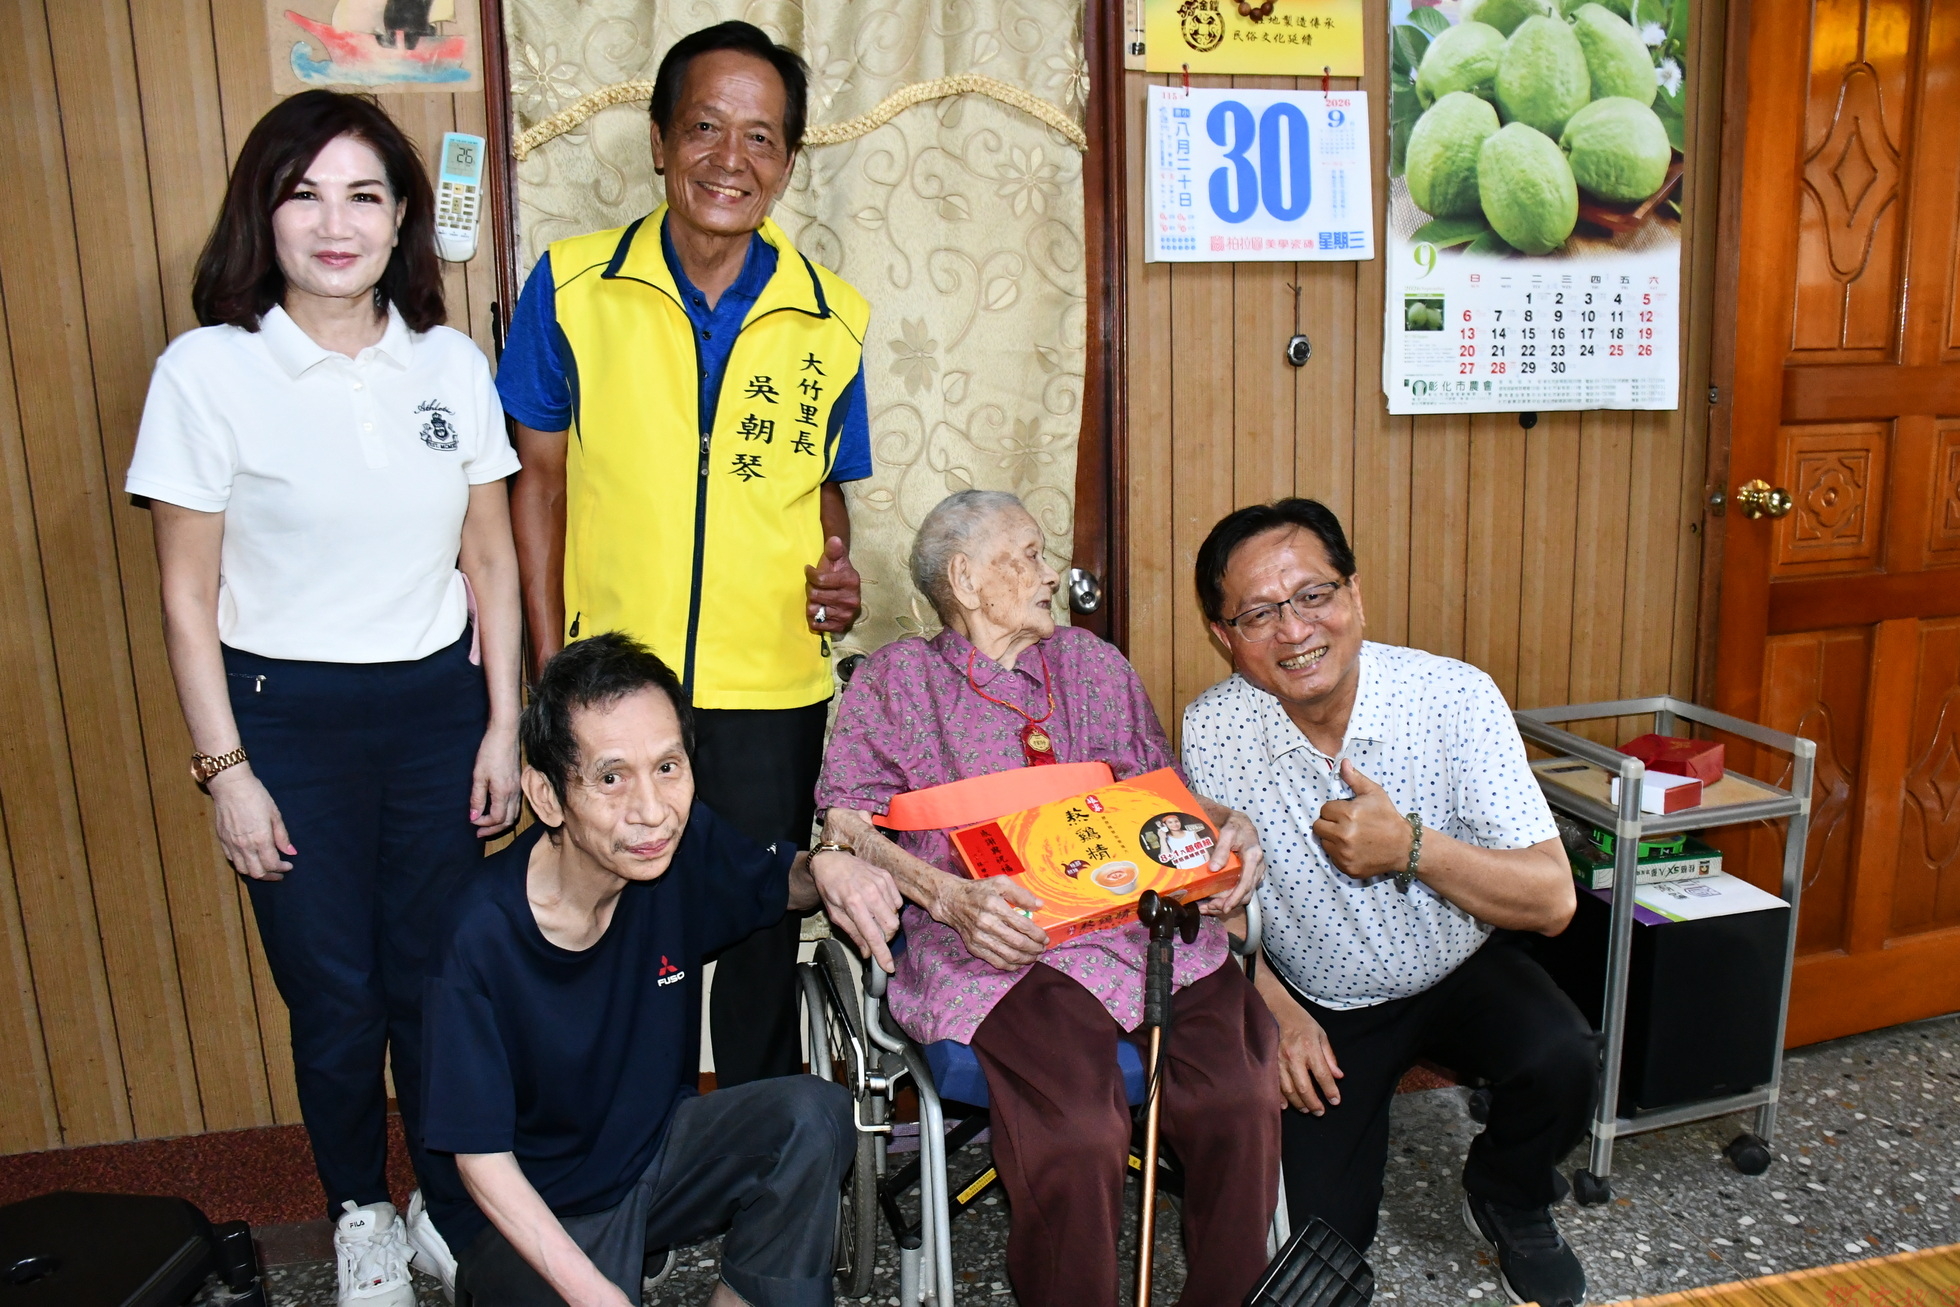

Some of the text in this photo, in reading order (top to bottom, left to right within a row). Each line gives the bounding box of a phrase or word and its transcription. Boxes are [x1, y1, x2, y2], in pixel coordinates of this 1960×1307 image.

[1232, 30, 1314, 46] 民俗文化延續
[1325, 98, 1352, 108] 2026
[1327, 109, 1346, 128] 9
[456, 147, 474, 165] 26
[1175, 121, 1192, 207] 八月二十日
[1205, 100, 1313, 224] 30
[1318, 230, 1366, 251] 星期三
[1413, 241, 1437, 280] 9
[1470, 273, 1481, 283] 日
[1531, 274, 1543, 283] 二
[1561, 274, 1573, 284] 三
[1590, 275, 1602, 285] 四
[1619, 275, 1631, 285] 五
[1648, 276, 1660, 285] 六
[1525, 292, 1651, 306] 1 2 3 4 5
[1462, 309, 1653, 323] 6 7 8 9 10 11 12
[1460, 327, 1653, 340] 13 14 15 16 17 18 19
[1459, 344, 1476, 357] 20
[1491, 344, 1505, 357] 21
[1520, 344, 1536, 357] 22
[1550, 344, 1566, 357] 23
[1579, 344, 1595, 357] 24
[1609, 344, 1624, 357] 25
[1637, 344, 1653, 357] 26
[1459, 361, 1566, 375] 27 28 29 30
[1428, 380, 1492, 392] 彰化市農會
[790, 352, 828, 457] 大竹里長
[728, 375, 780, 482] 吳朝琴
[657, 971, 685, 987] FUSO
[349, 1220, 365, 1228] FILA
